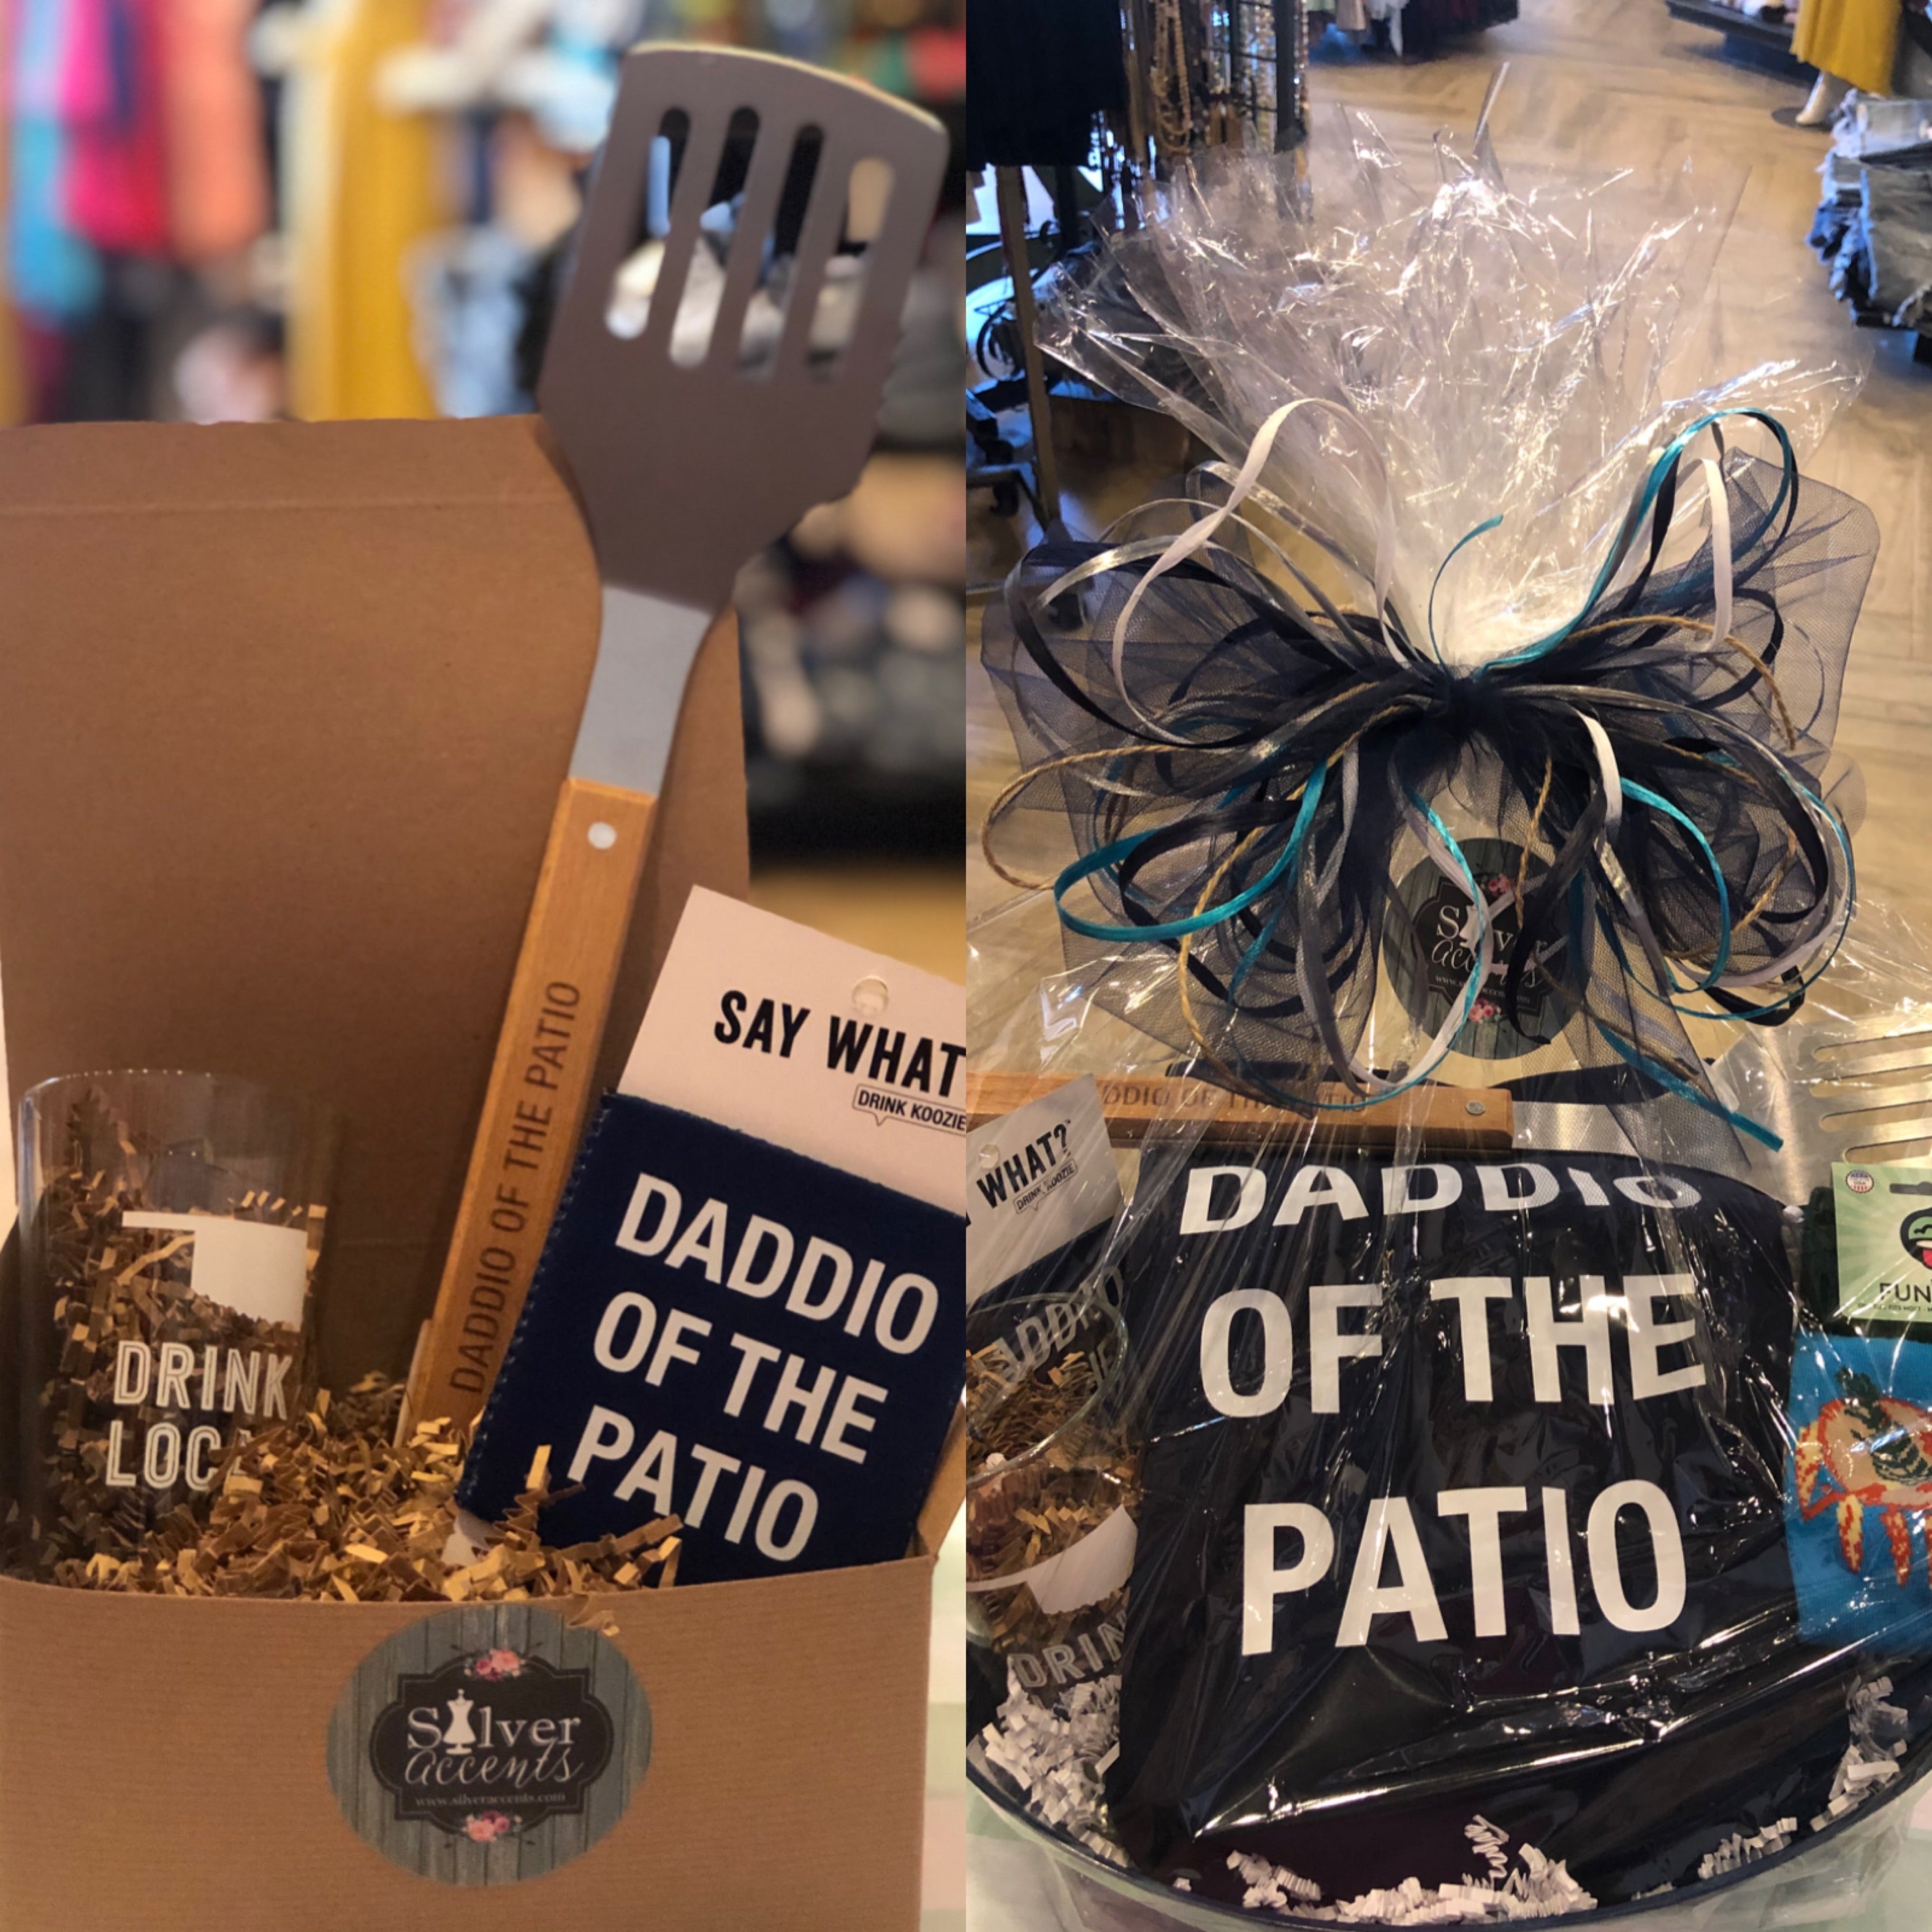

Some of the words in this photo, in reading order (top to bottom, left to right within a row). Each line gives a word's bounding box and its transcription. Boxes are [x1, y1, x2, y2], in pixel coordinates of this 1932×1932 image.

[524, 981, 580, 1091] PATIO
[714, 990, 811, 1059] SAY
[827, 1015, 966, 1097] WHAT
[503, 1100, 554, 1172] THE
[858, 1089, 907, 1117] DRINK
[910, 1103, 966, 1131] KOOZIE
[490, 1182, 530, 1233] OF
[976, 1124, 1068, 1209] WHAT?
[1180, 1163, 1702, 1235] DADDIO
[615, 1172, 938, 1355] DADDIO
[449, 1246, 517, 1394] DADDIO
[1200, 1283, 1383, 1418] OF
[1430, 1272, 1706, 1405] THE
[113, 1341, 293, 1420] DRINK
[594, 1291, 712, 1386] OF
[723, 1332, 889, 1464] THE
[567, 1405, 819, 1562] PATIO
[1241, 1479, 1687, 1656] PATIO
[1013, 1609, 1127, 1687] DRIN
